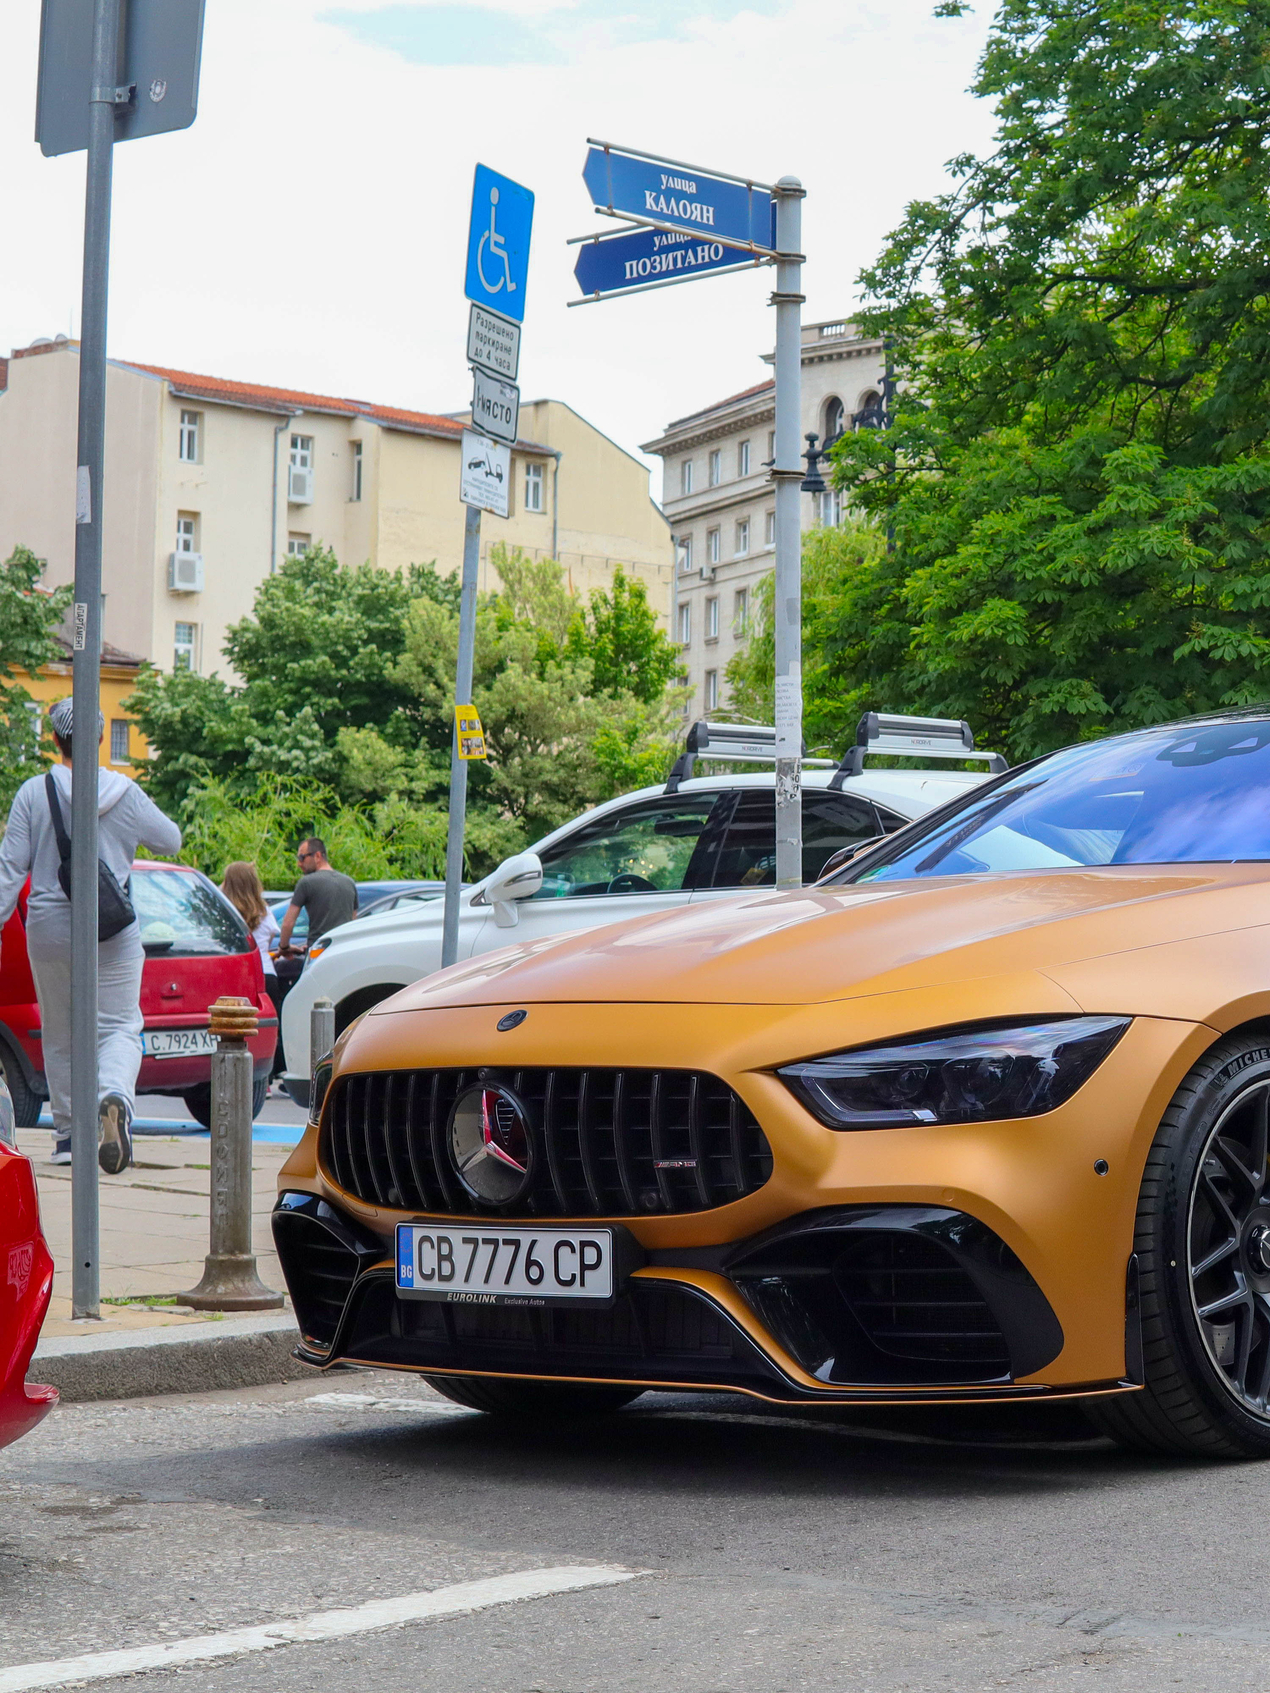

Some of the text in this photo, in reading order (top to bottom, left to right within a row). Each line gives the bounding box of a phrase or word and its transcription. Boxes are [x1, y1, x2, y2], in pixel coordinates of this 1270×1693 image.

[660, 174, 697, 194] улица
[644, 190, 715, 226] КАЛОЯН
[624, 243, 724, 280] ПОЗИТАНО
[476, 312, 515, 341] Разрешено
[486, 350, 491, 361] 4
[495, 356, 511, 371] часа
[401, 1235, 603, 1288] BG CB 7776 CP
[447, 1292, 498, 1304] EUROLINK
[504, 1297, 529, 1305] Exclusive
